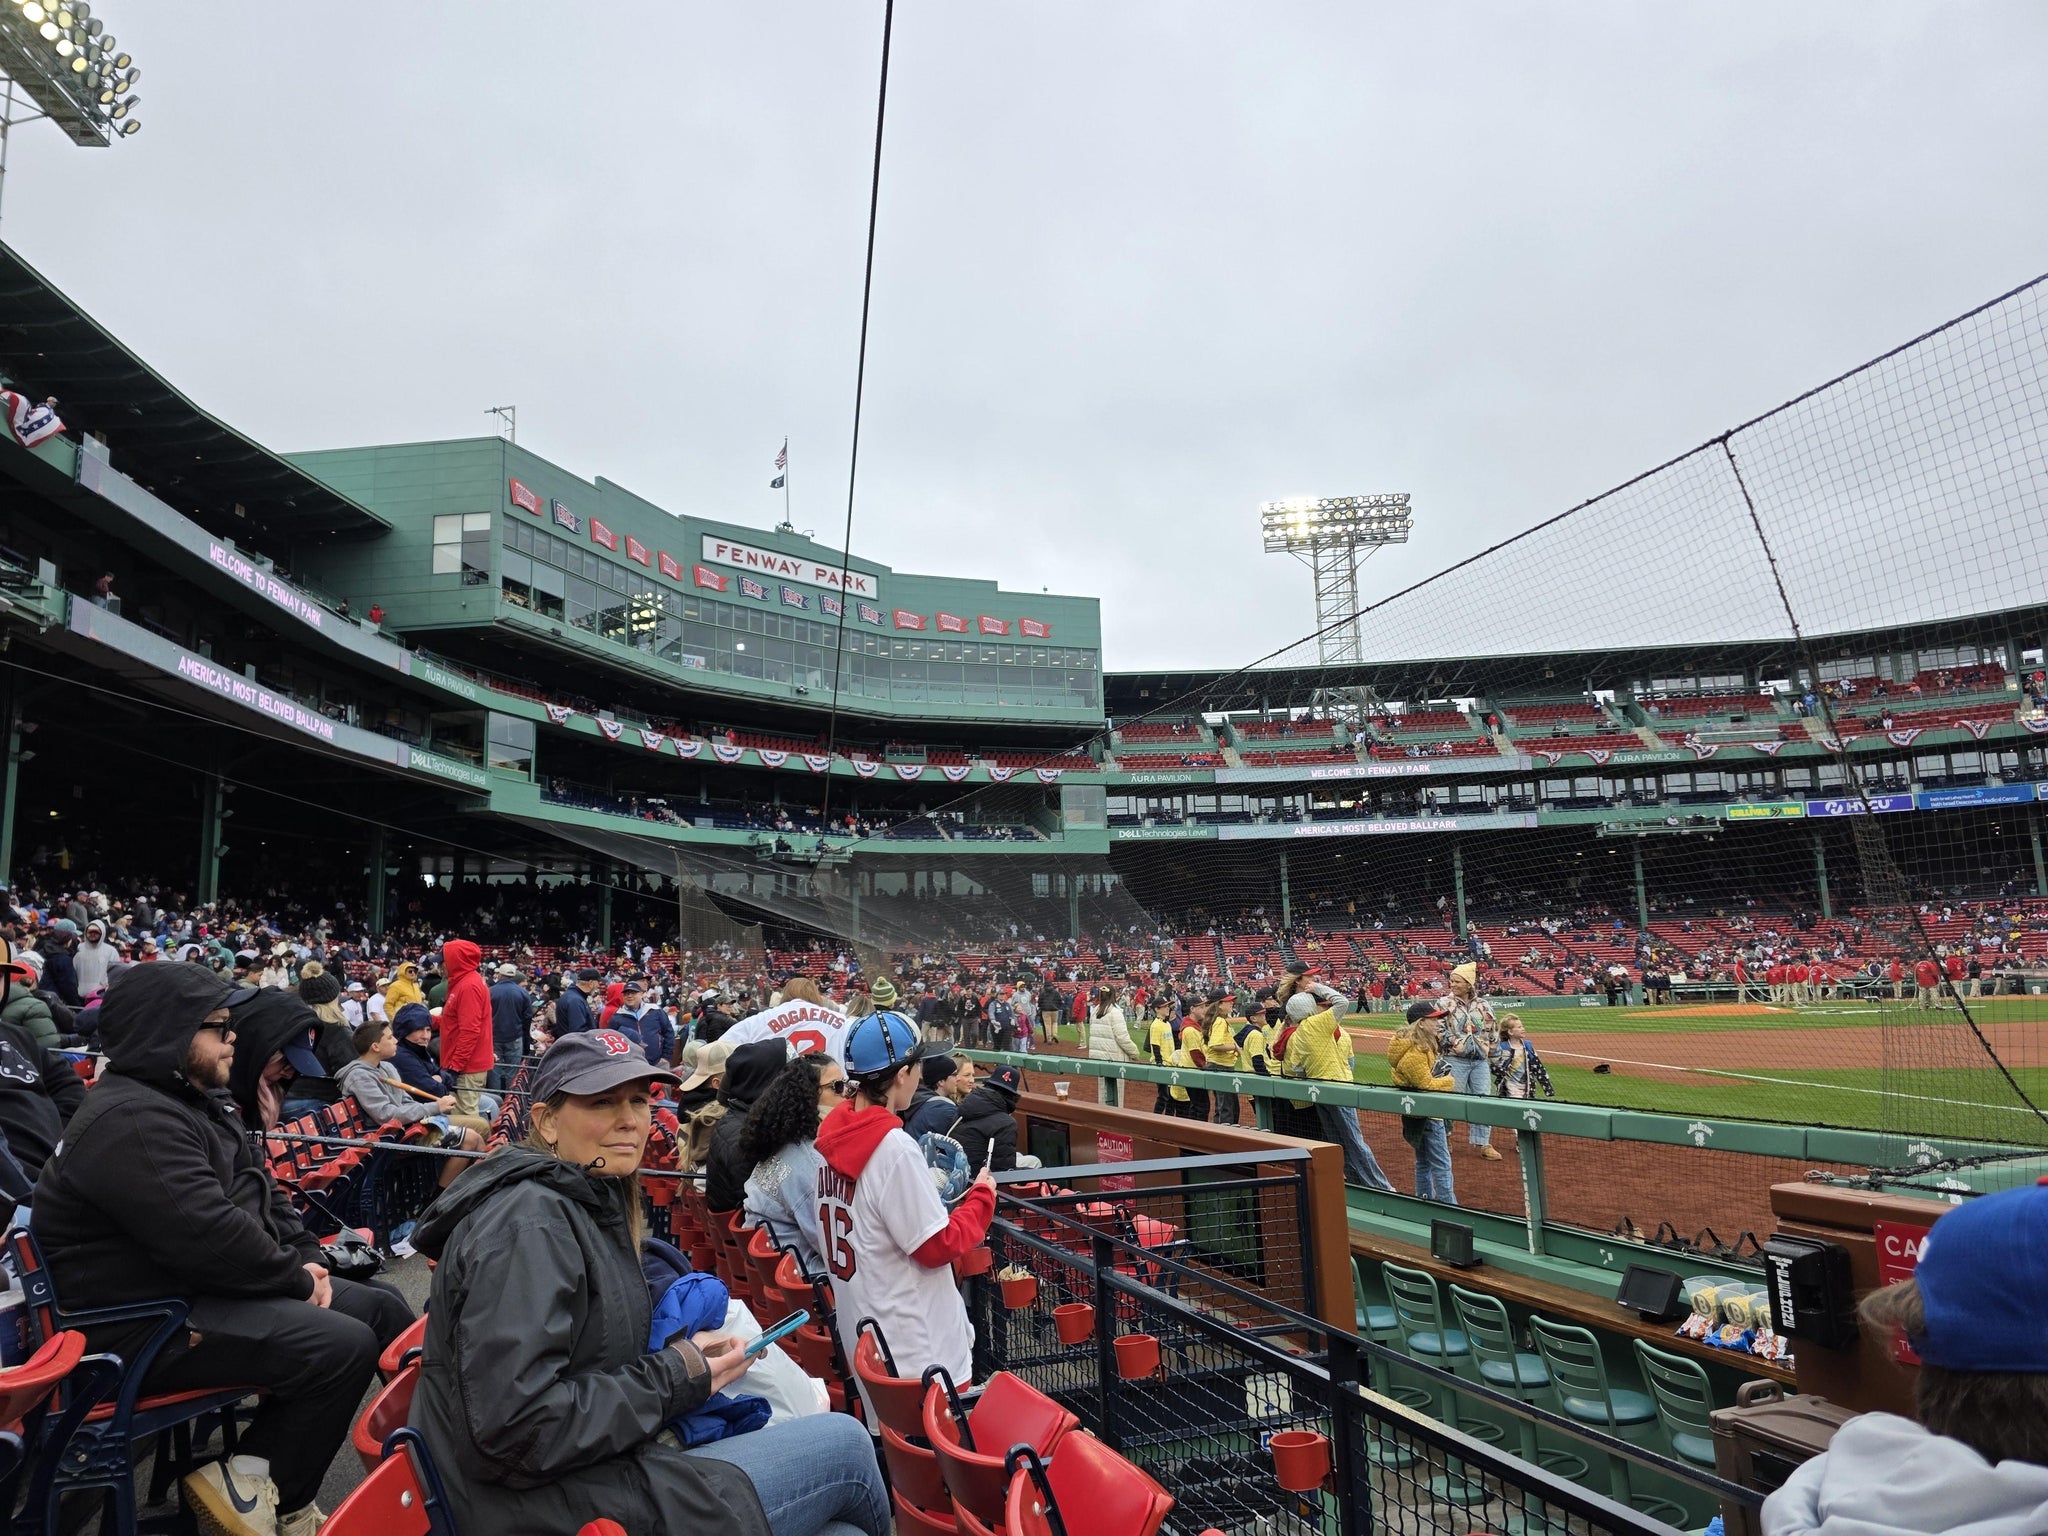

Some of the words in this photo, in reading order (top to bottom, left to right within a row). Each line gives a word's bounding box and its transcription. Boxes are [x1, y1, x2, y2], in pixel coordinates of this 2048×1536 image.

[716, 543, 802, 576] FENWAY
[815, 567, 867, 592] PARK
[210, 542, 252, 583] WELCOME
[255, 571, 265, 591] TO
[267, 580, 300, 612] FENWAY
[301, 602, 321, 627] PARK
[447, 678, 476, 698] PAVILION
[178, 655, 231, 692] AMERICA'S
[232, 680, 257, 702] MOST
[258, 691, 295, 722] BELOVED
[296, 709, 334, 740] BALLPARK
[1641, 753, 1680, 761] PAVILION
[411, 751, 432, 769] DELL
[432, 758, 470, 781] Technologies
[470, 773, 486, 785] Level
[1311, 768, 1351, 778] WELCOME
[1354, 767, 1365, 775] TO
[1368, 765, 1404, 775] FENWAY
[1406, 764, 1431, 773] PARK
[1730, 805, 1770, 818] SULLIVAN
[1782, 807, 1801, 815] TIRE
[1118, 829, 1141, 838] DELL
[1141, 828, 1188, 839] Technologies
[1188, 827, 1208, 837] Level
[1294, 825, 1340, 836] AMERICA'S
[1342, 824, 1366, 833] MOST
[1368, 822, 1408, 832] BELOVED
[1410, 820, 1457, 830] BALLPARK
[767, 1007, 846, 1034] BOGAERTS
[595, 1032, 631, 1056] B
[1098, 1137, 1132, 1154] CAUTION!
[1906, 1143, 1920, 1157] JIM
[1920, 1142, 1943, 1160] BEAM
[819, 1203, 857, 1283] 16
[32, 1282, 47, 1295] C
[1557, 1341, 1563, 1349] 3
[1664, 1371, 1671, 1380] 2
